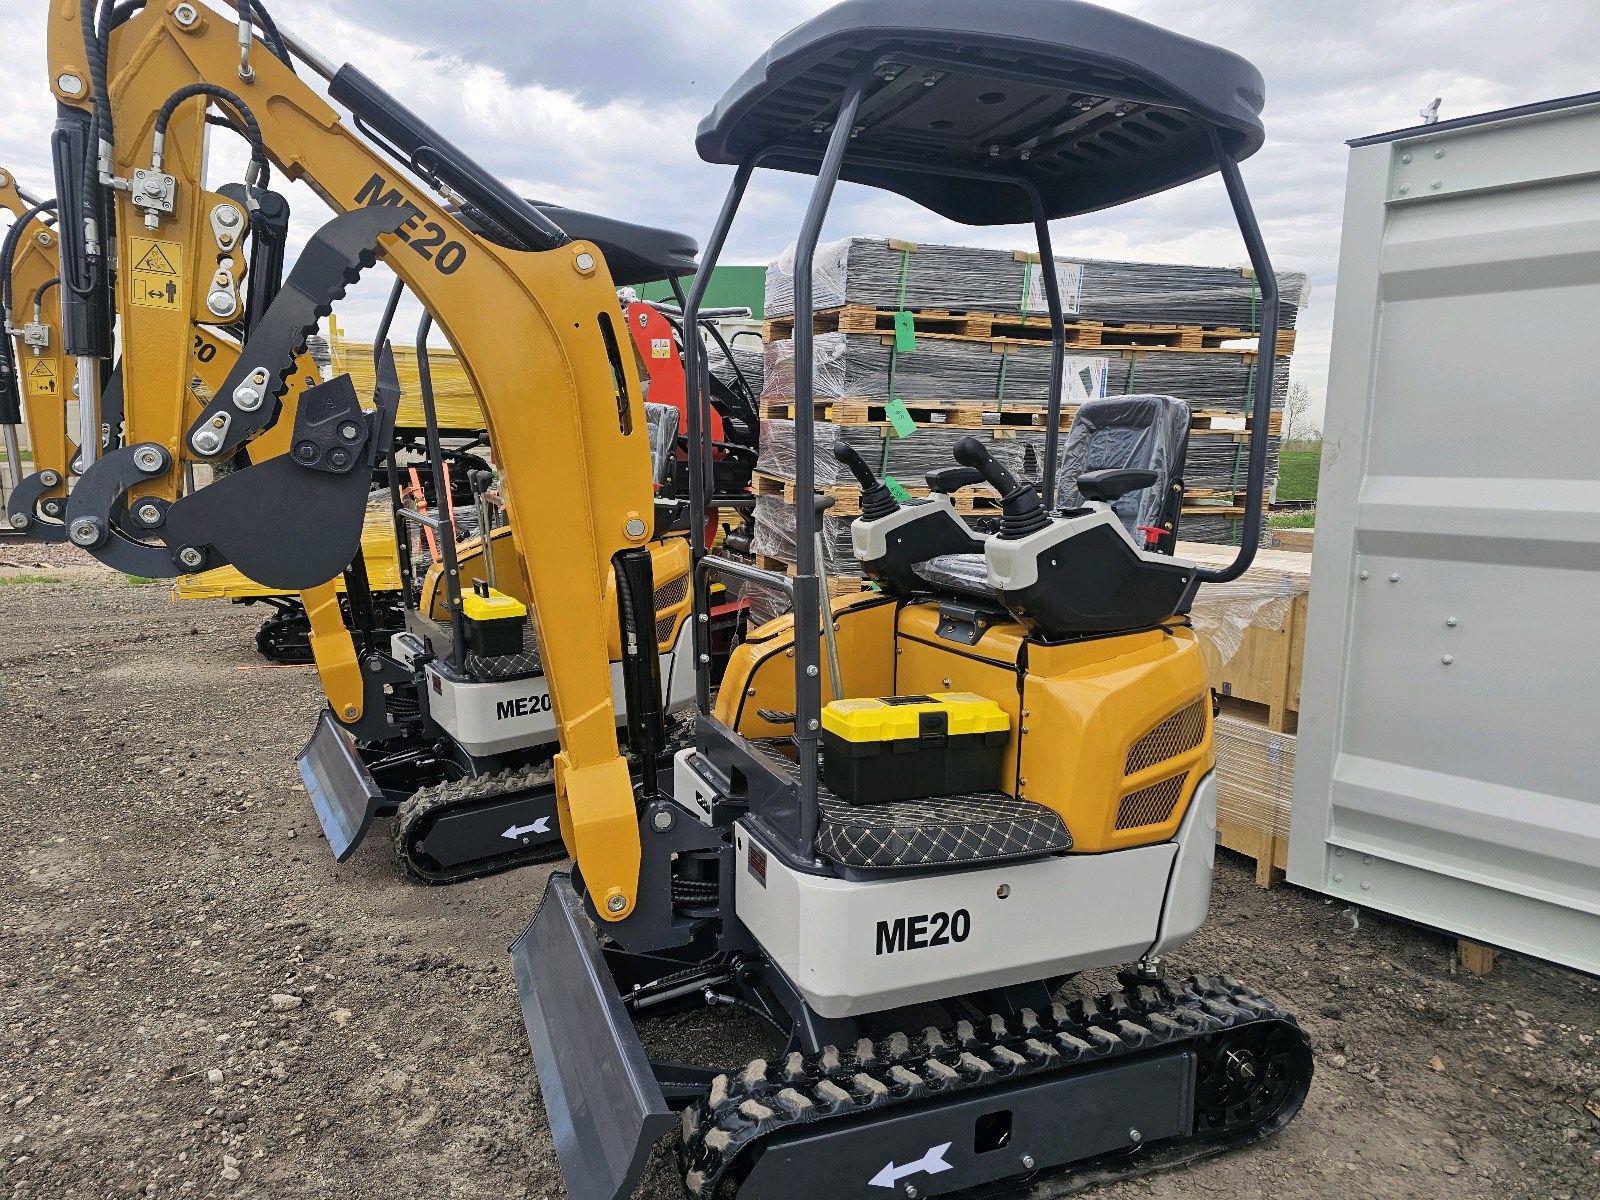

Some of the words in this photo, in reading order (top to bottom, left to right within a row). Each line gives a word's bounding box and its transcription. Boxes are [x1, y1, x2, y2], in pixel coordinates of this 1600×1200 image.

[354, 173, 467, 275] ME20
[496, 693, 552, 721] ME20
[876, 908, 971, 955] ME20
